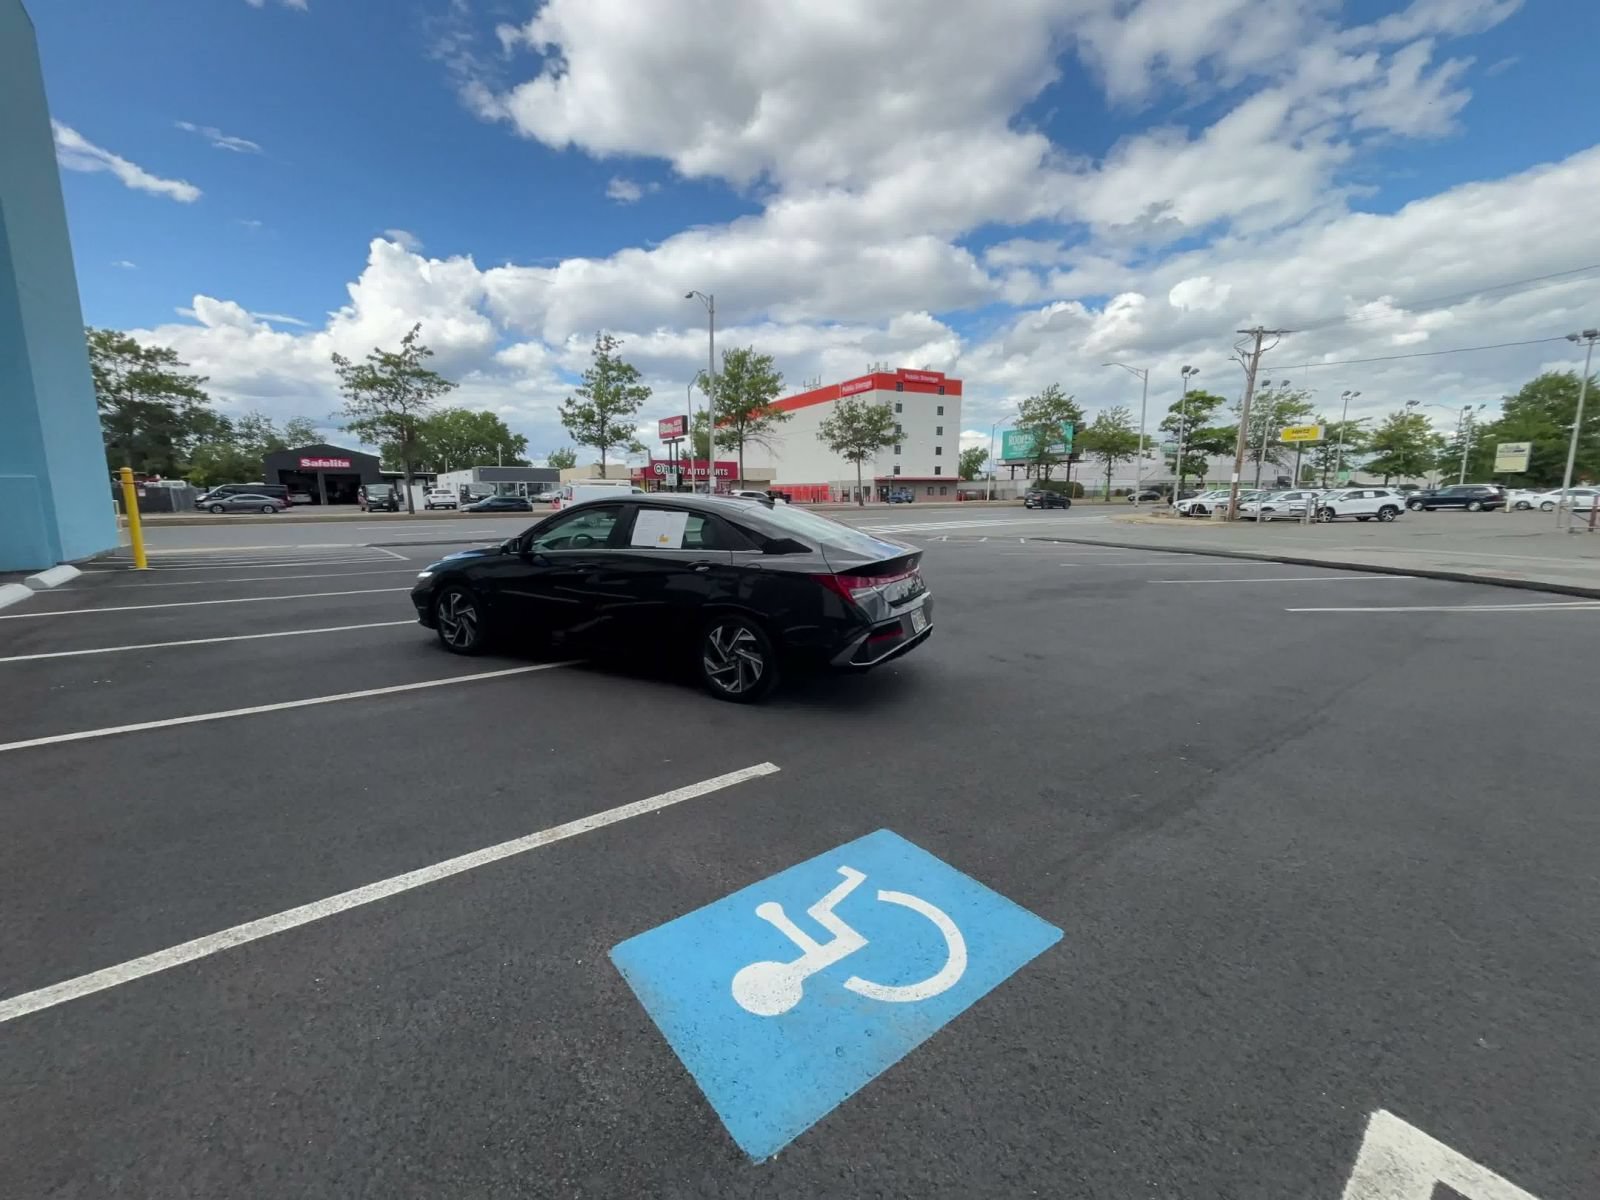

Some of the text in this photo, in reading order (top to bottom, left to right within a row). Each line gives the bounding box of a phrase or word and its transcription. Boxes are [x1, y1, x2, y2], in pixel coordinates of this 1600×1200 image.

[300, 458, 351, 468] Safelite
[687, 467, 706, 476] AUTO
[707, 468, 729, 476] PRTS
